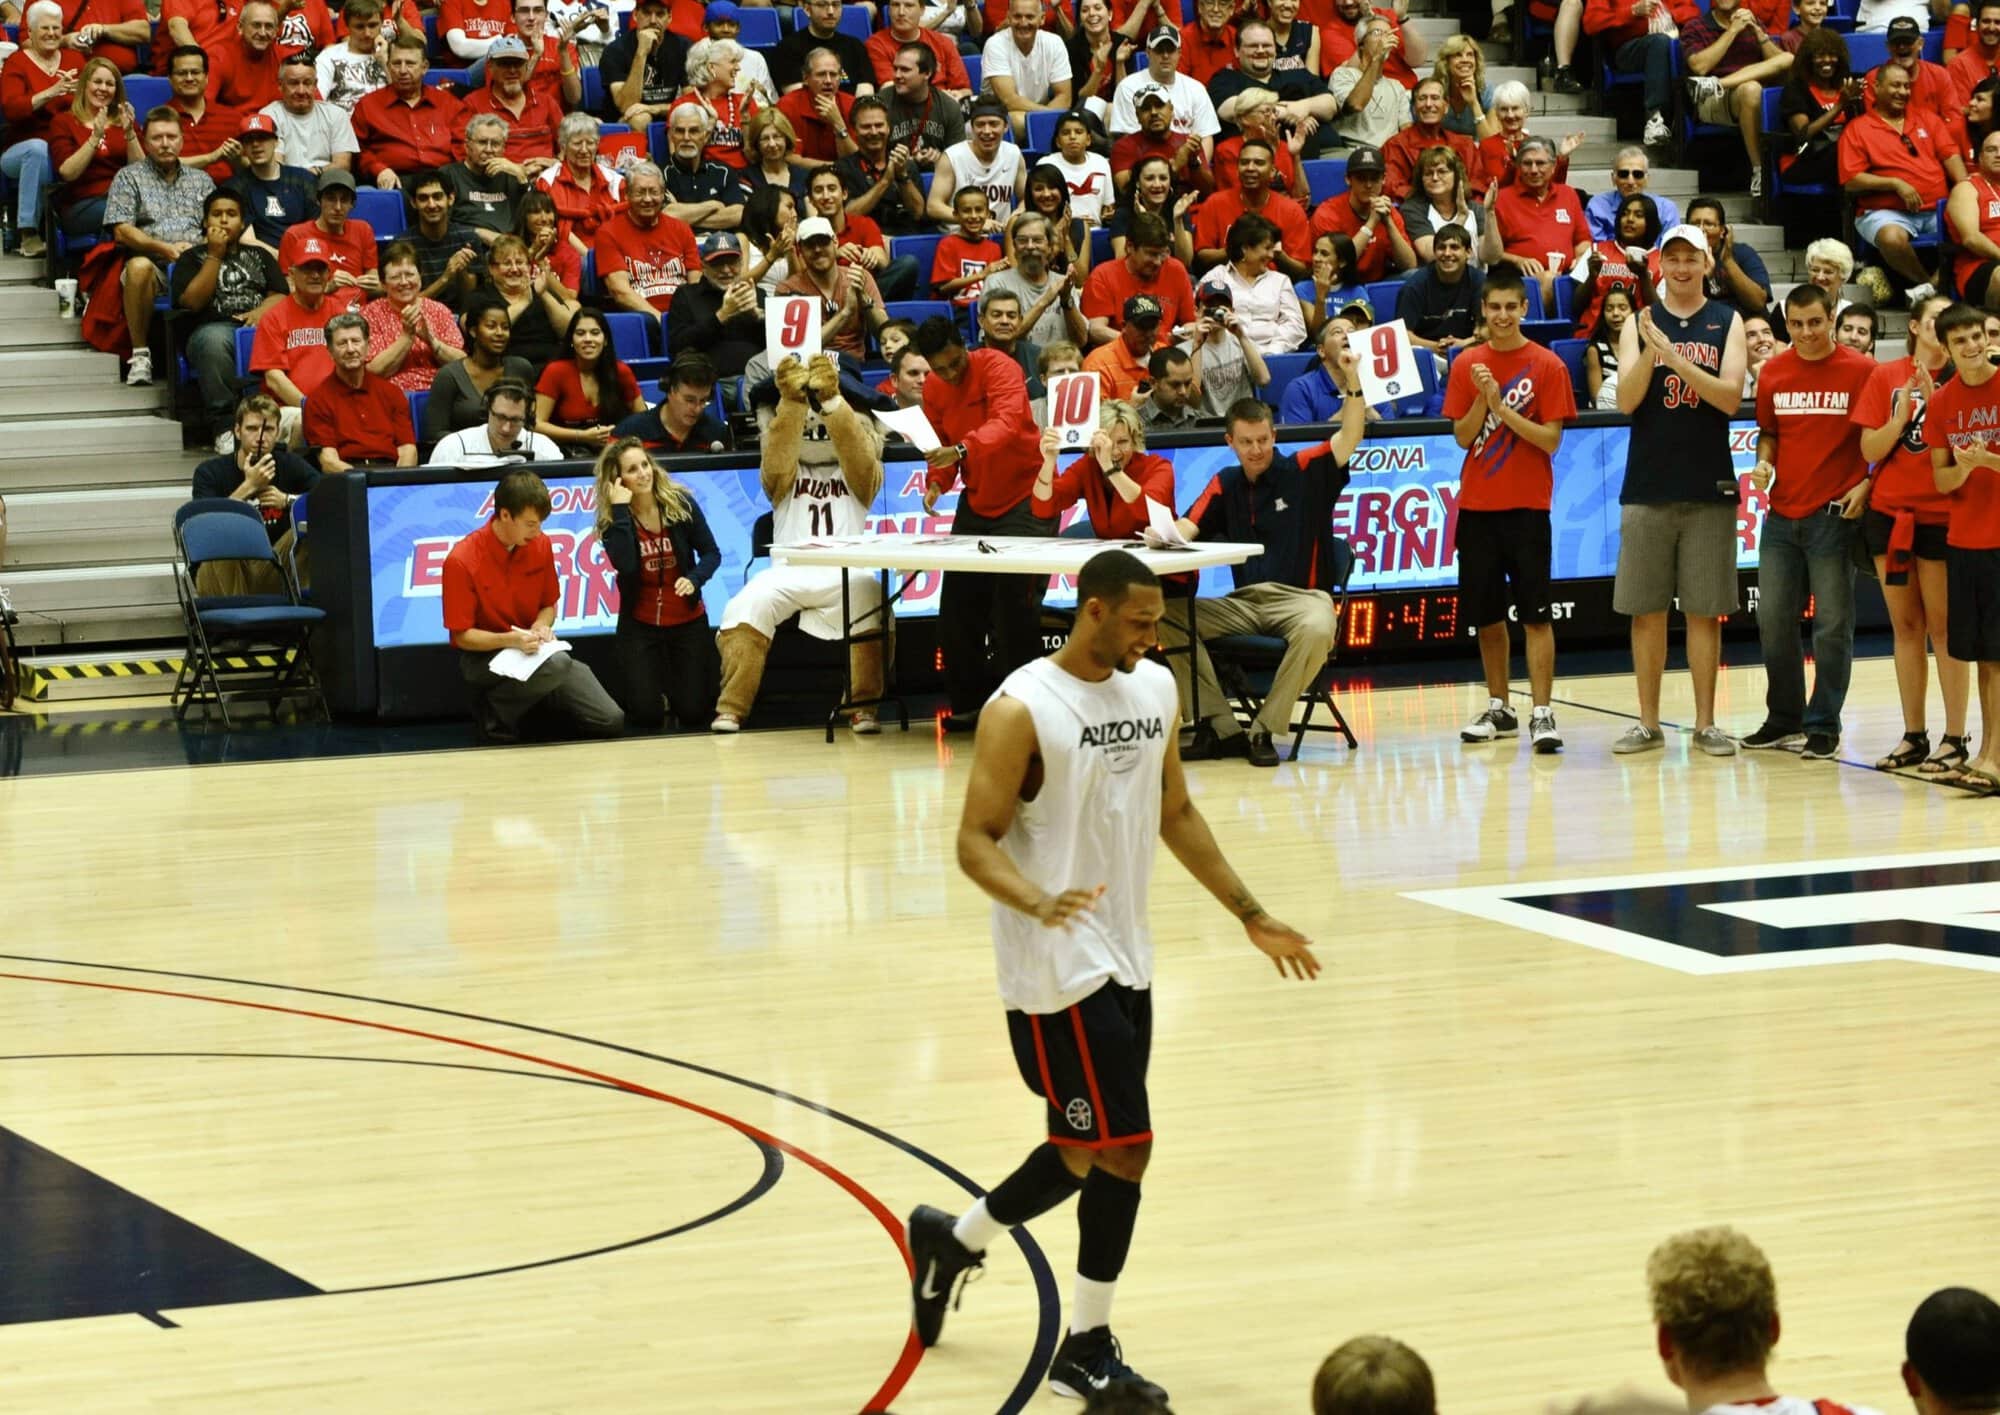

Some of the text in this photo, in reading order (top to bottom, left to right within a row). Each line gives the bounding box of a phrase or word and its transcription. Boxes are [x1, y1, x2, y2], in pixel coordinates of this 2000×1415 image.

[780, 298, 810, 349] 9
[1370, 326, 1399, 380] 9
[1053, 375, 1095, 428] 10
[1663, 374, 1699, 408] 34
[1773, 391, 1850, 409] WILDCAT FAN
[1957, 404, 1998, 430] I AM
[794, 478, 849, 500] ARIZONA
[808, 502, 834, 537] 11
[1079, 717, 1164, 749] ARIZONA
